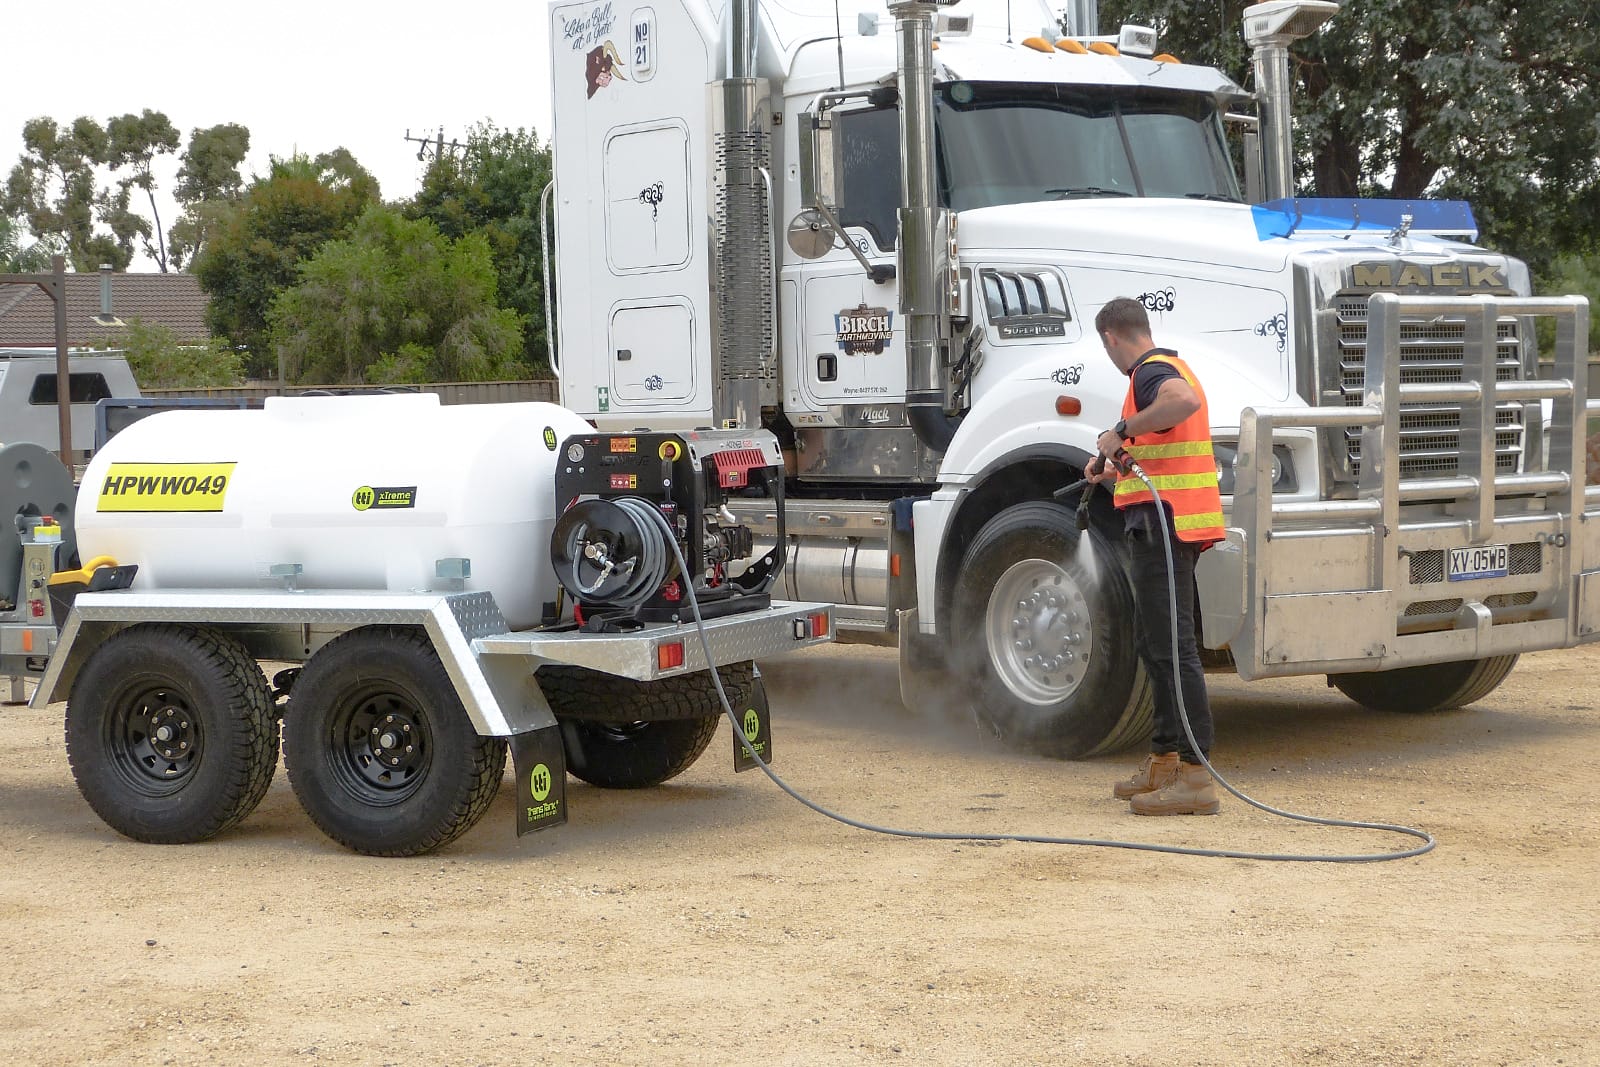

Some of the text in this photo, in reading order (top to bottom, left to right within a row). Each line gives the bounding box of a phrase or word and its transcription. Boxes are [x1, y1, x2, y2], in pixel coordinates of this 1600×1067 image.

[572, 34, 585, 50] at
[636, 45, 647, 65] 21
[1352, 264, 1504, 287] MACK
[838, 315, 890, 334] BIRCH
[836, 331, 893, 342] EARTHMOVING
[860, 406, 891, 424] Mack
[102, 475, 227, 496] HPWW049
[379, 491, 411, 500] xTreme
